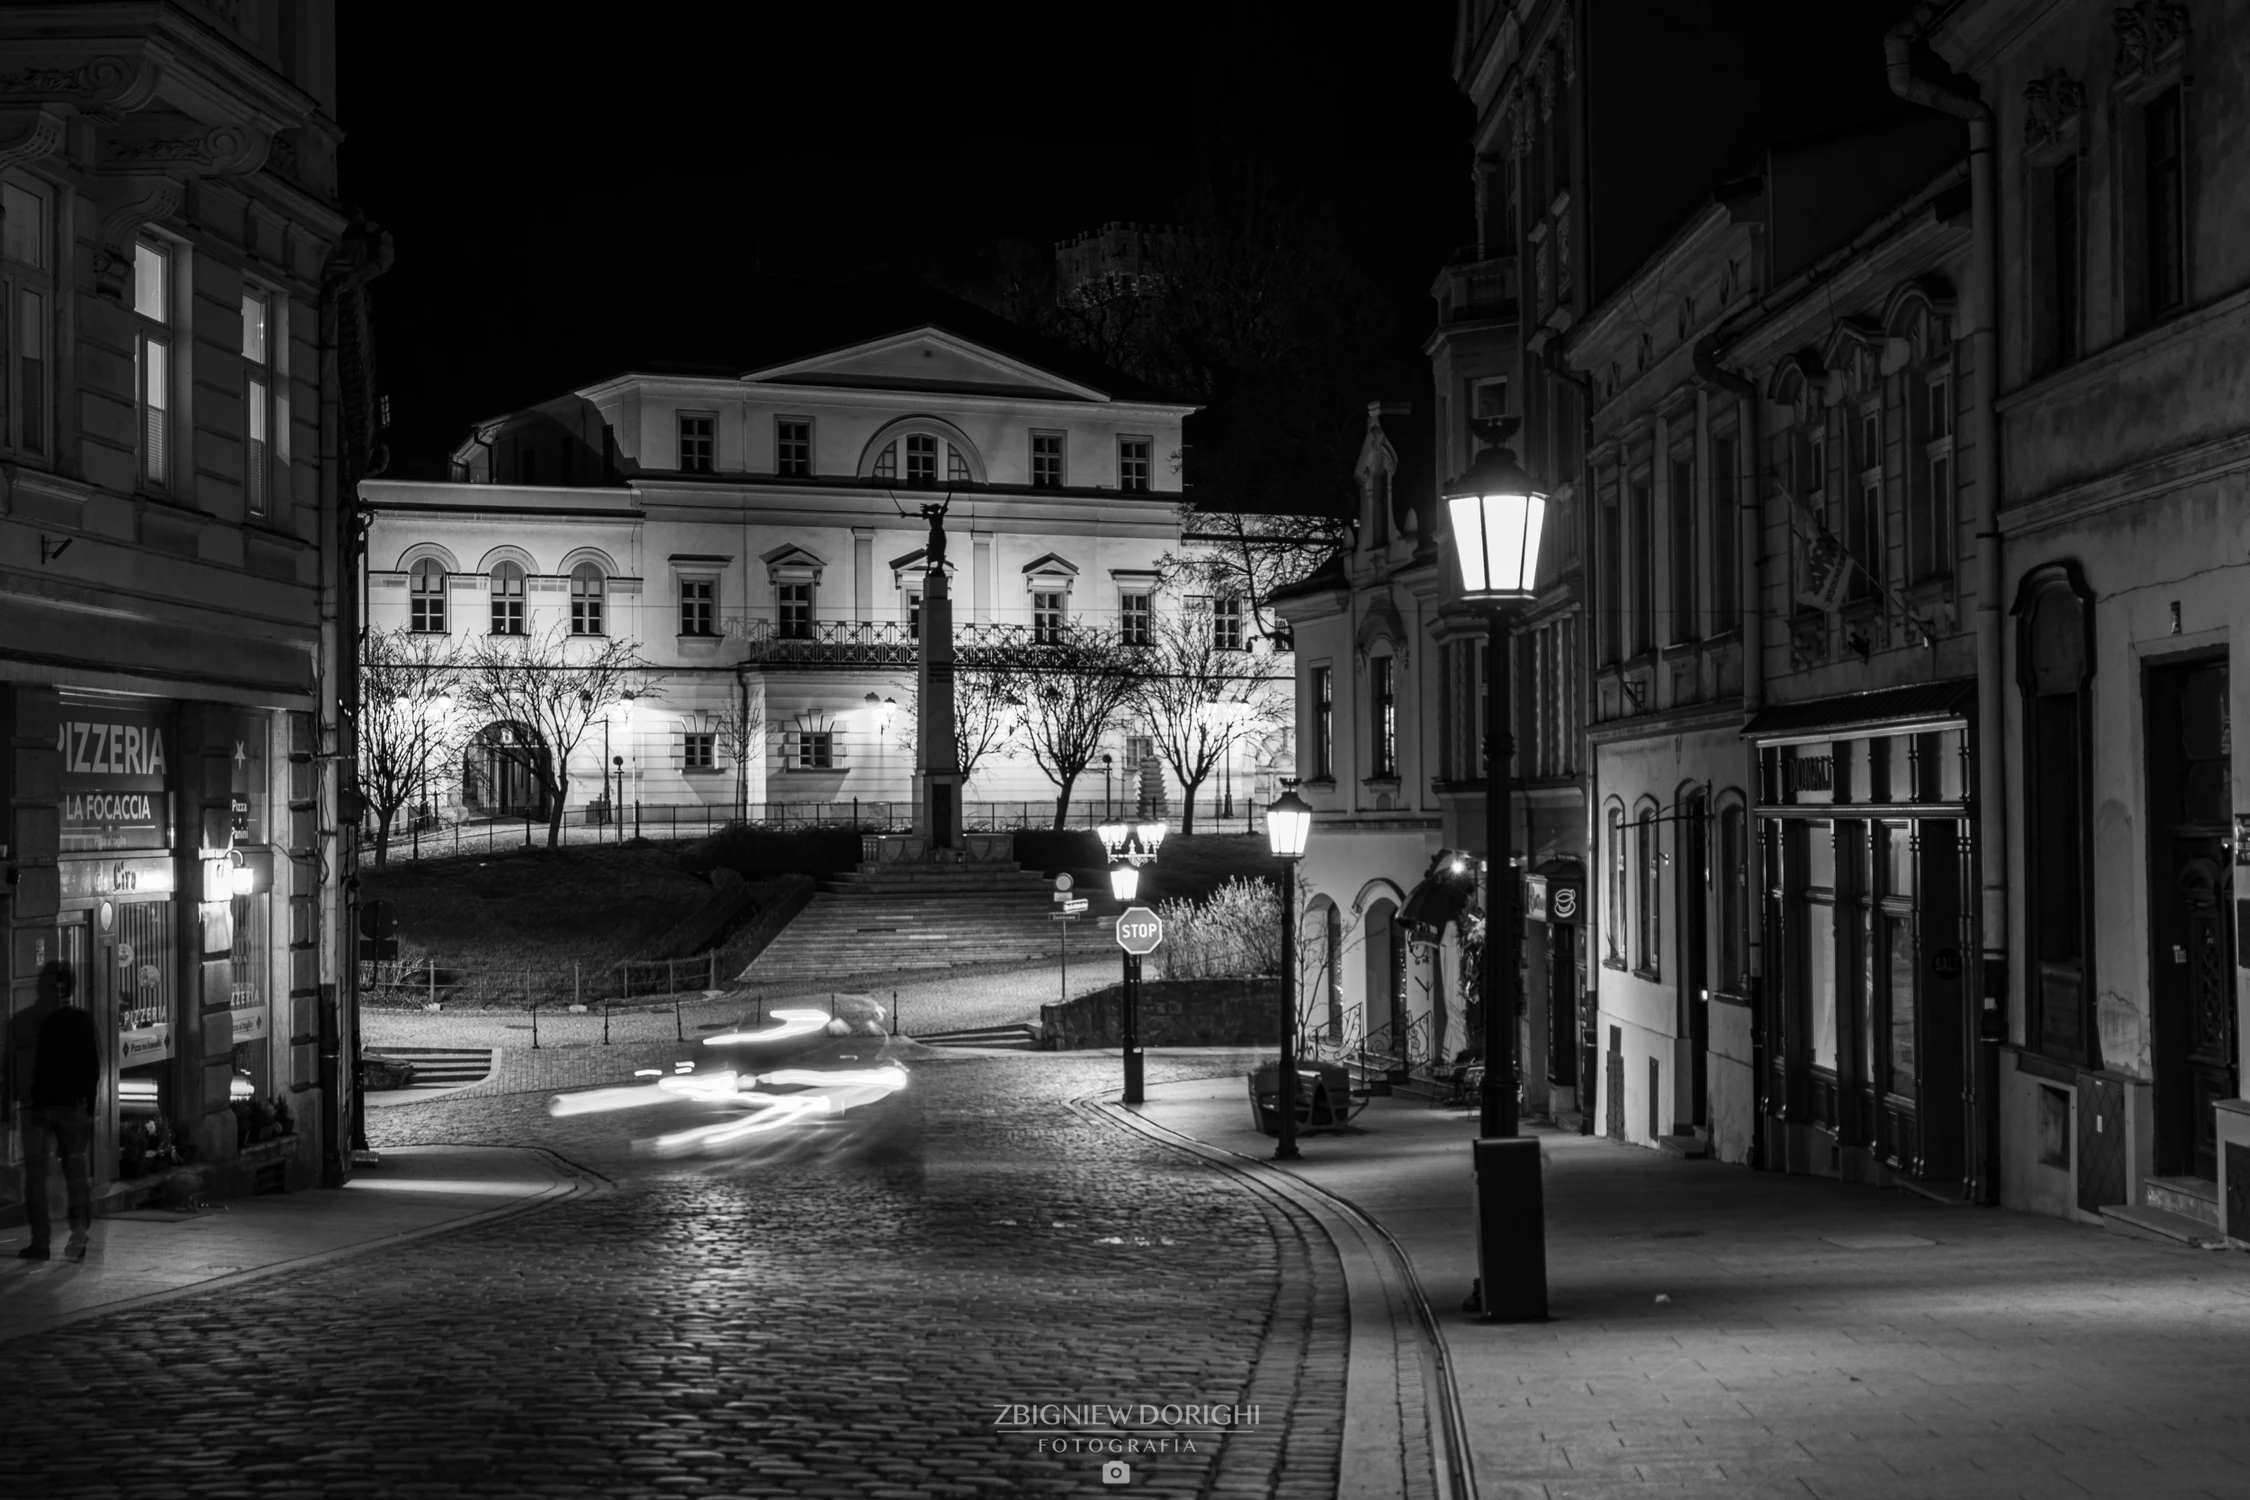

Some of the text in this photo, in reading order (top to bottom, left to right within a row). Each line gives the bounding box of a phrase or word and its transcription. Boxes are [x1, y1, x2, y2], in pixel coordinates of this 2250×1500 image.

[66, 795, 151, 820] LA FOCACCIA
[231, 799, 248, 812] Pizza
[231, 826, 248, 839] Panini
[1122, 924, 1157, 939] STOP
[124, 1005, 167, 1025] PIZZERIA
